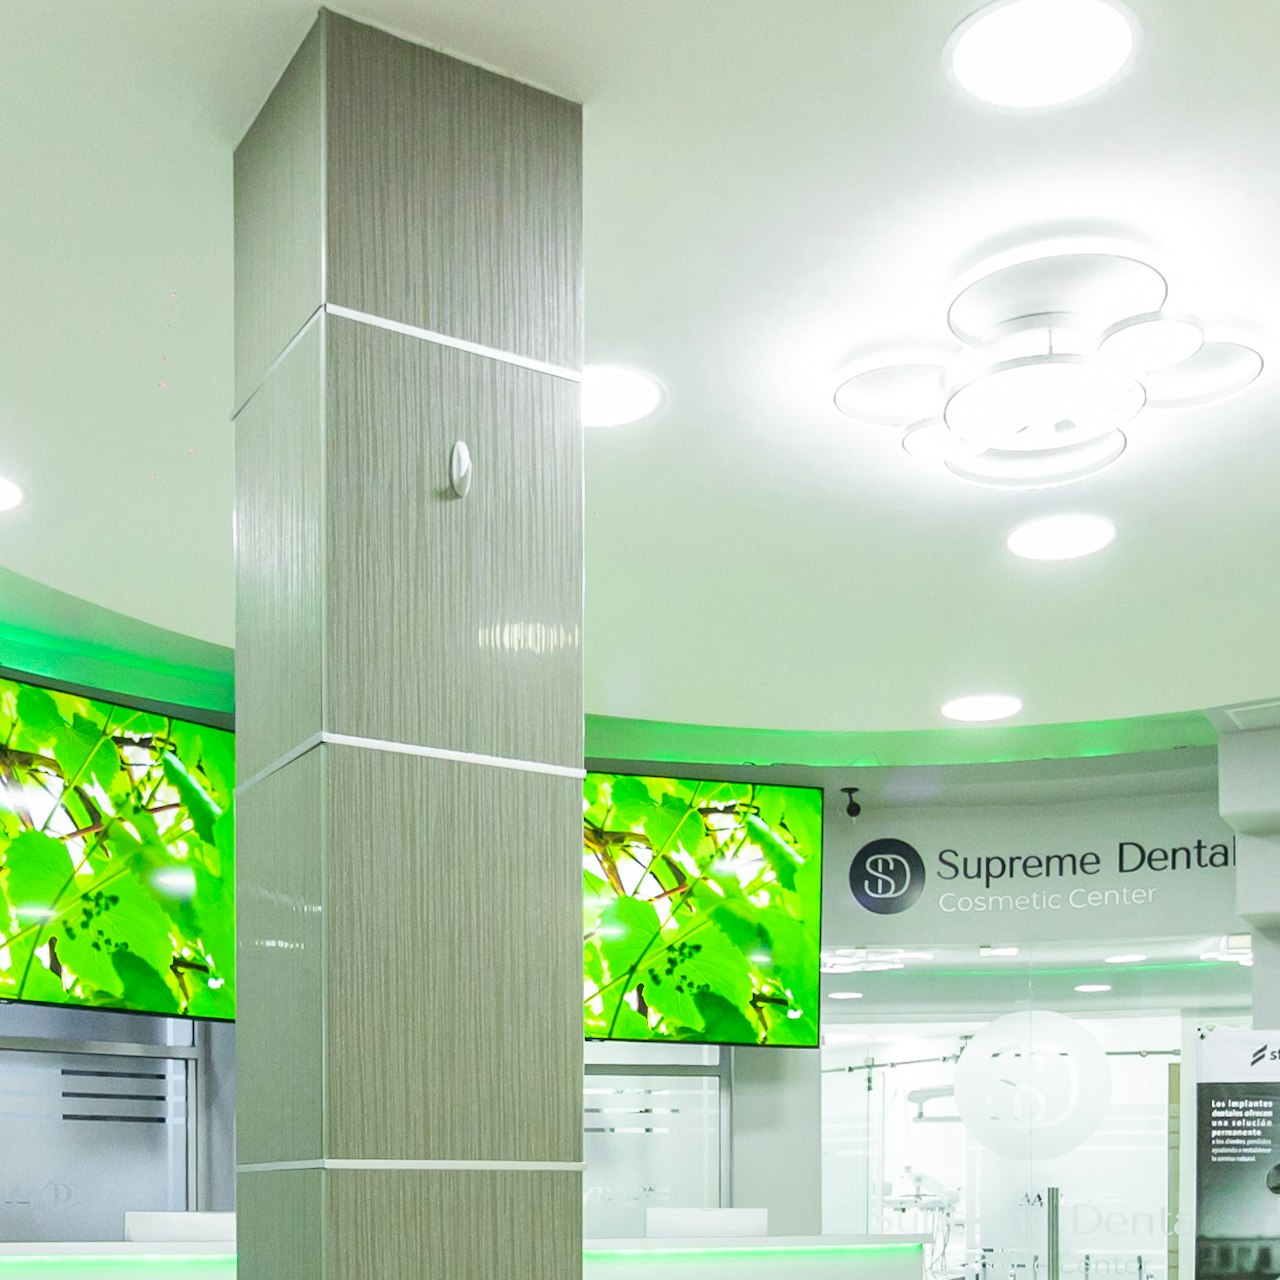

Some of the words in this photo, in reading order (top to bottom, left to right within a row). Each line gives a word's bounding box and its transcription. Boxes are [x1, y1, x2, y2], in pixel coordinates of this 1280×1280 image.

[936, 848, 1101, 889] Supreme
[1118, 834, 1237, 874] Dental
[938, 890, 1062, 913] Cosmetic
[1068, 885, 1158, 908] Center
[1211, 1100, 1226, 1108] Los
[1228, 1099, 1273, 1109] implantes
[1211, 1109, 1243, 1117] dentales
[1244, 1109, 1273, 1117] ofrecen
